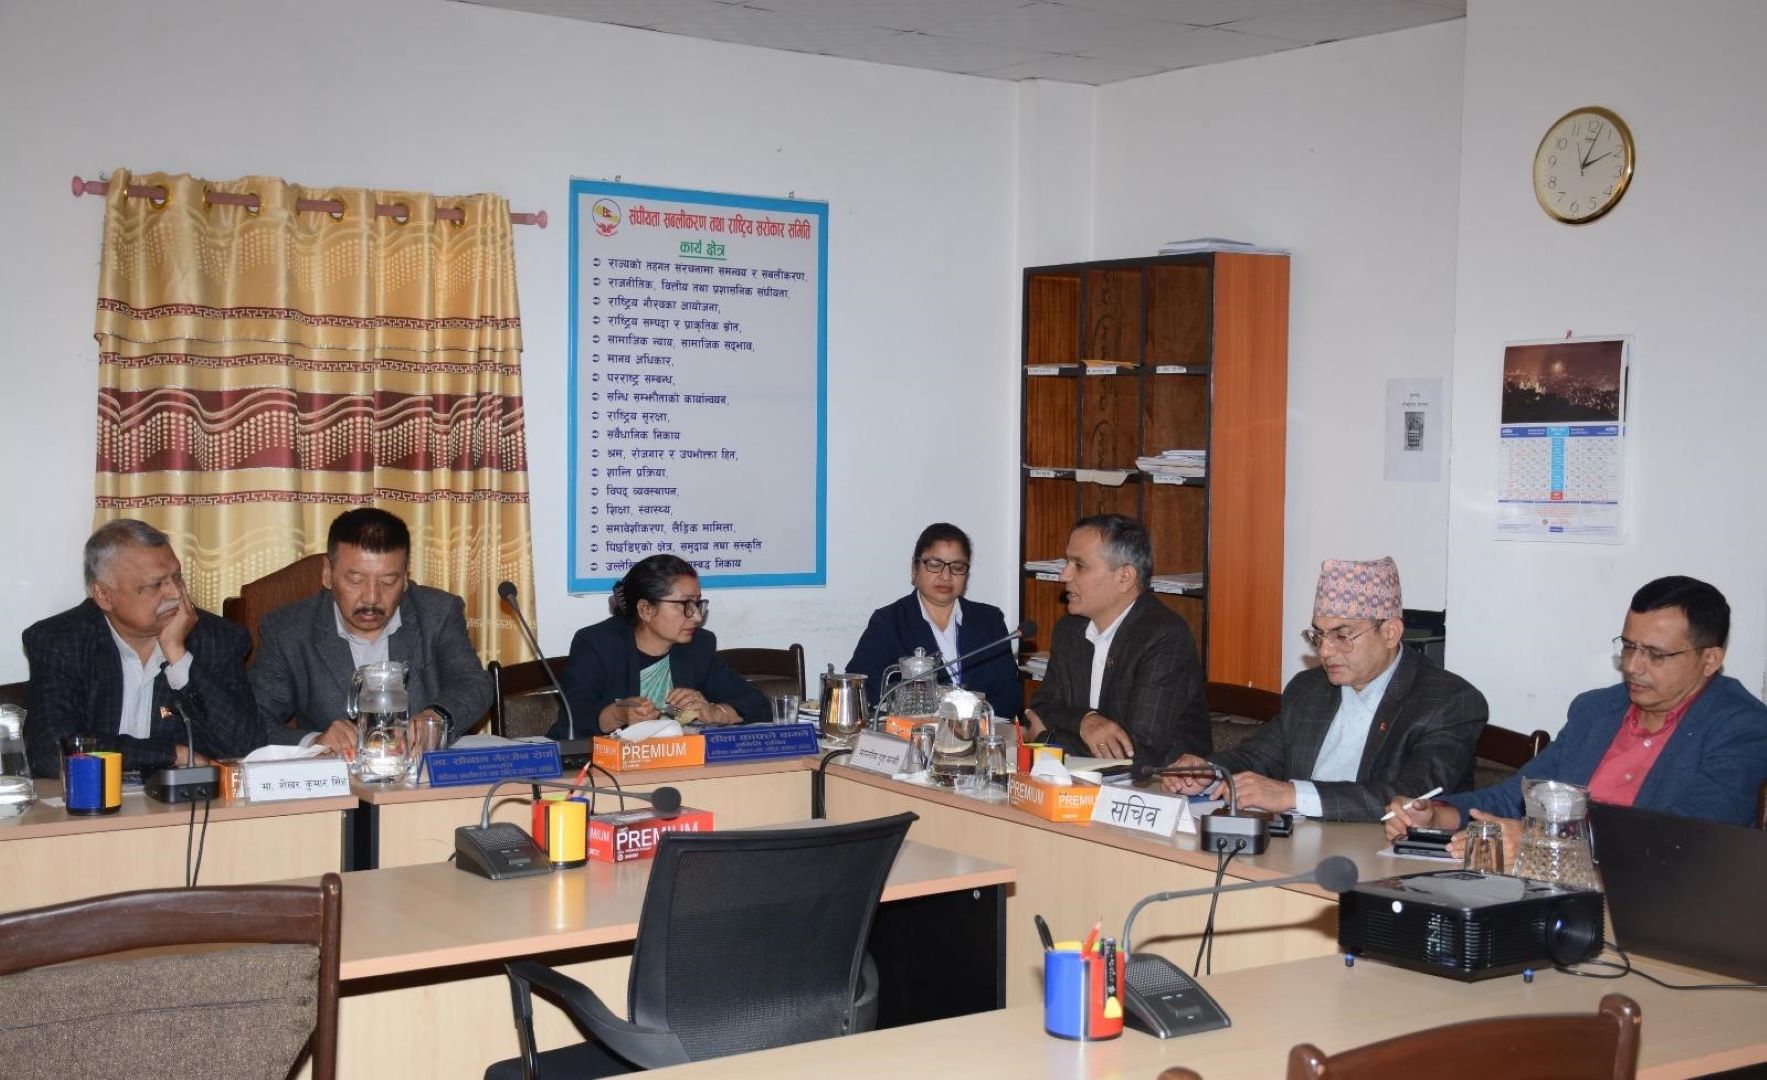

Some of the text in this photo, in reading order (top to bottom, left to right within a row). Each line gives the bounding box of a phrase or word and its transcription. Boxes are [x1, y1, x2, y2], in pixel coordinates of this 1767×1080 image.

[710, 217, 725, 232] तथा
[755, 216, 785, 237] सरोकार
[788, 219, 811, 239] समिति
[679, 239, 725, 256] कार्य क्षेत्र
[622, 742, 687, 761] PREMIUM
[1010, 779, 1045, 806] PREMIUM
[1059, 794, 1097, 808] PREMIU
[1111, 795, 1161, 828] सचिव
[616, 821, 699, 850] PREMM
